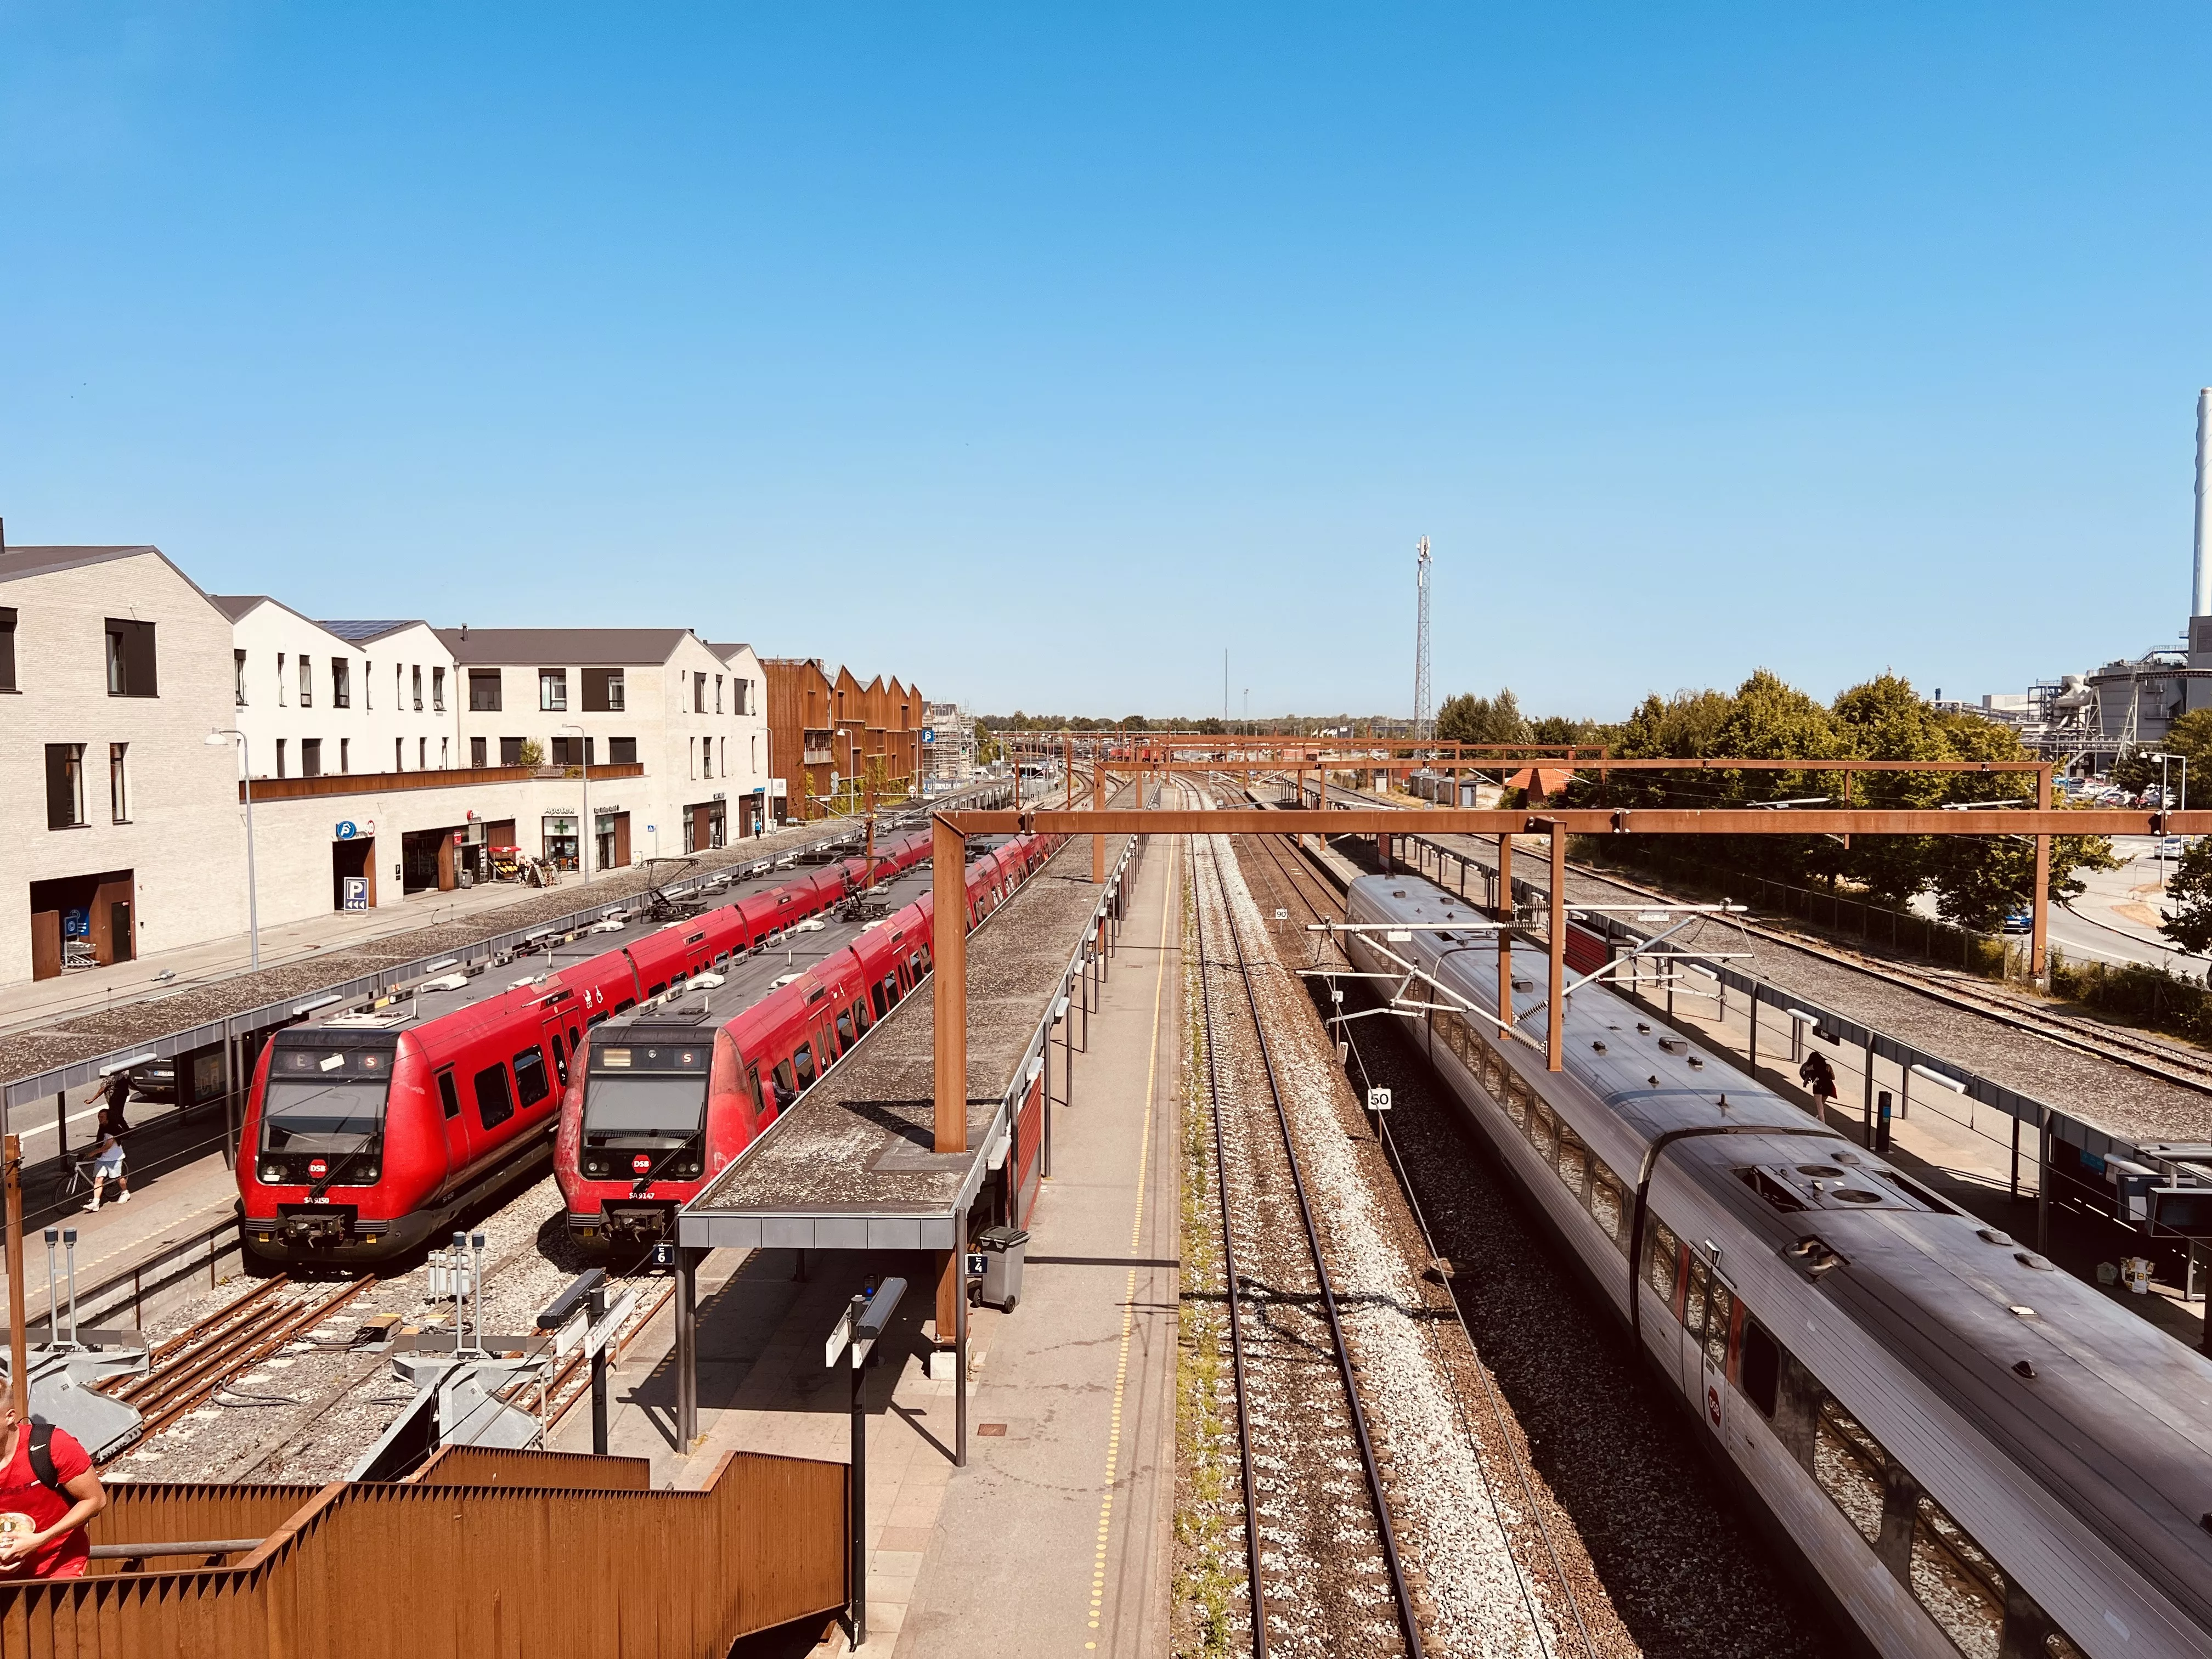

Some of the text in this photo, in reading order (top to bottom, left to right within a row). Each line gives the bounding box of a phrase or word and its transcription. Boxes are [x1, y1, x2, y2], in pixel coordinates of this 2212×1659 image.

[544, 806, 575, 816] Apotek
[349, 882, 363, 899] P
[297, 1054, 305, 1066] E
[367, 1057, 375, 1066] S
[684, 1054, 691, 1063] S
[1370, 1093, 1389, 1105] 50
[658, 1252, 665, 1262] 6
[974, 1262, 982, 1272] 4
[1709, 1396, 1719, 1417] DSB
